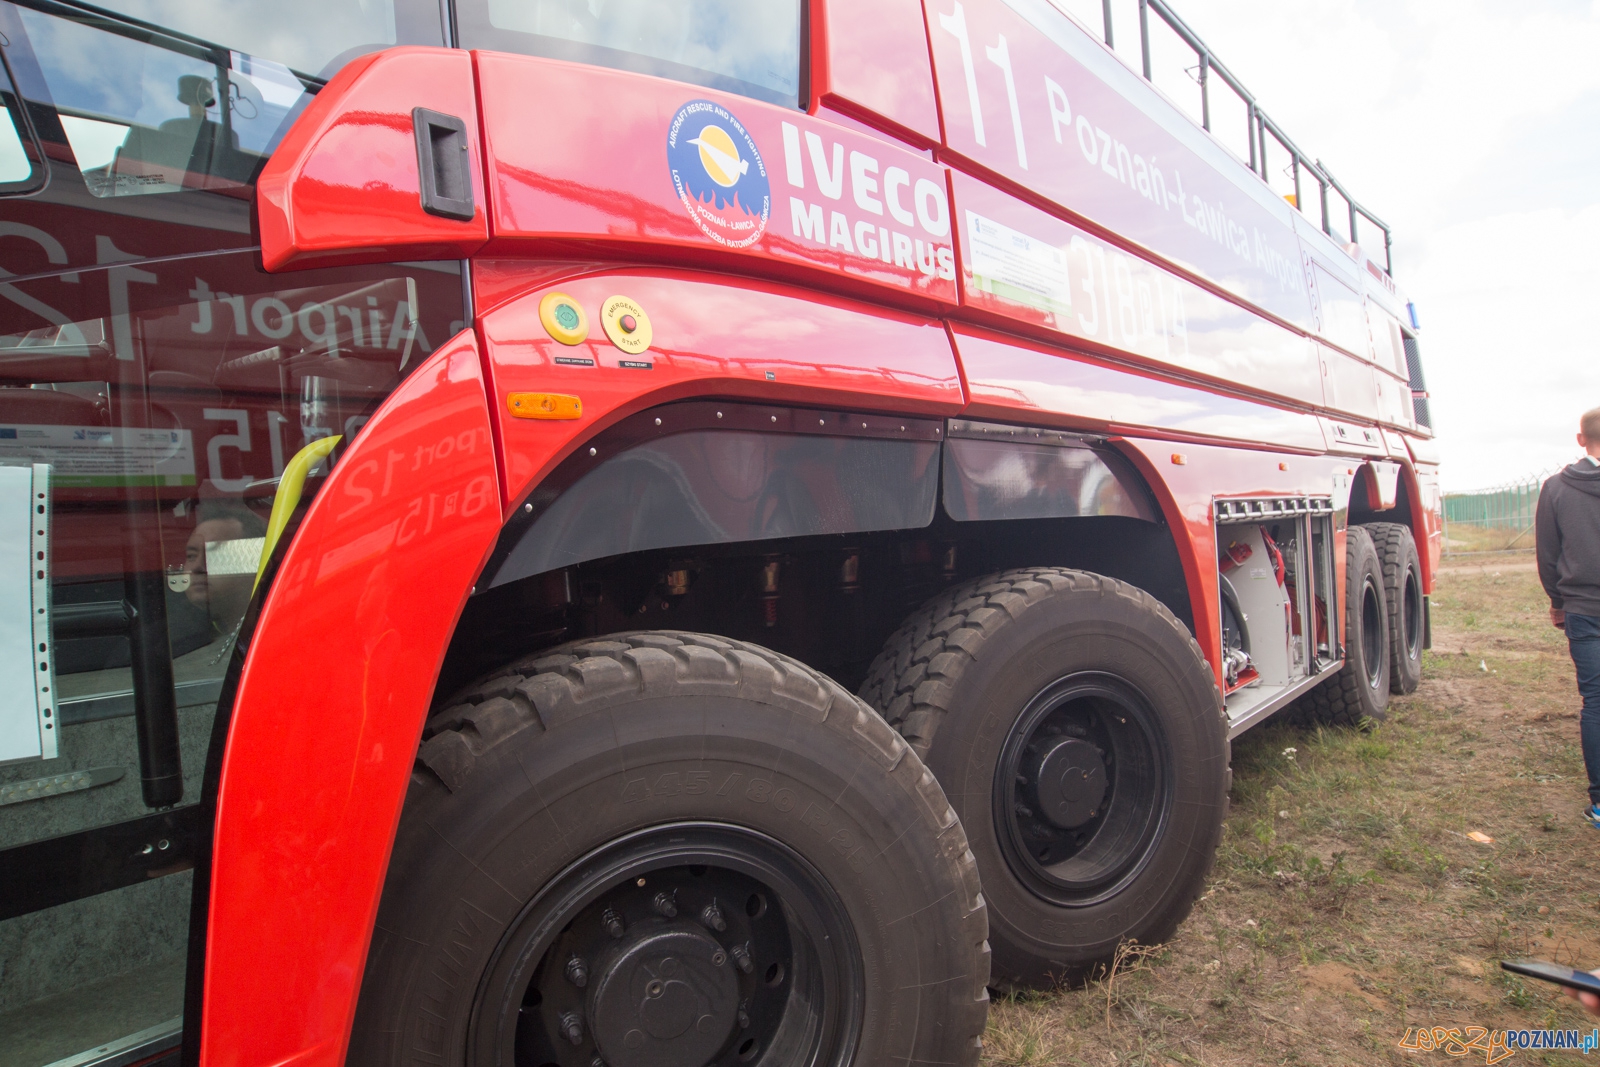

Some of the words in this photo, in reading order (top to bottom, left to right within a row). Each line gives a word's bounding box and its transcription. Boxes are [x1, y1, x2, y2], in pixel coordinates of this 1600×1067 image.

[938, 0, 1029, 171] 11
[669, 109, 688, 149] AIRCRAFT
[686, 102, 713, 115] RESCUE
[714, 106, 730, 120] AND
[729, 116, 745, 136] FIRE
[744, 134, 767, 178] FIGHTING
[671, 169, 702, 227] LOTNISKOWA
[781, 120, 950, 238] IVECO
[788, 195, 956, 281] MAGIRUS
[1253, 227, 1306, 297] Airport
[608, 301, 641, 318] EMERGENCY
[621, 337, 641, 346] START
[620, 770, 798, 813] 445/80
[800, 801, 834, 836] R
[828, 828, 875, 876] 25
